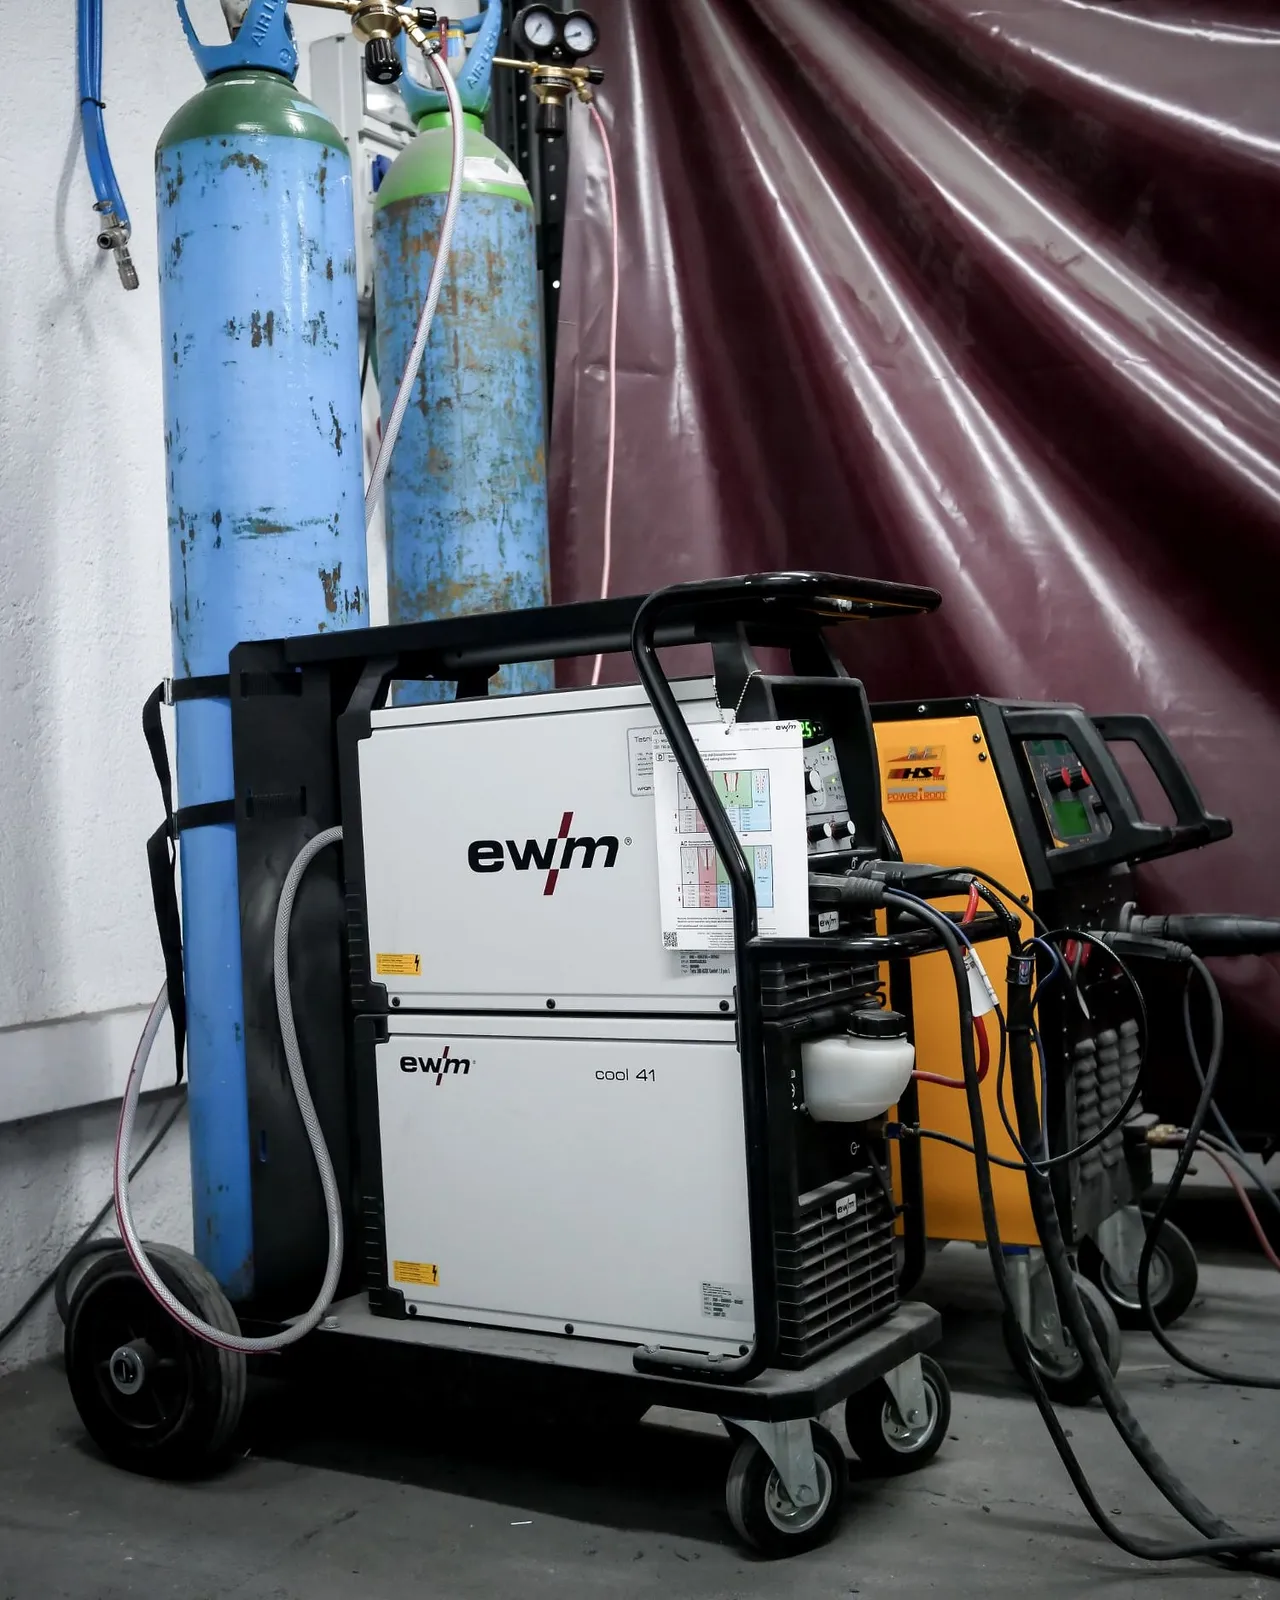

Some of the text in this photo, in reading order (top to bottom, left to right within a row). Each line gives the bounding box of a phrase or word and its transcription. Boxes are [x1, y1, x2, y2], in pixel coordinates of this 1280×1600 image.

[251, 12, 271, 47] AIR
[466, 61, 485, 90] AIR
[903, 766, 945, 779] HSL
[595, 1068, 656, 1082] cool 41
